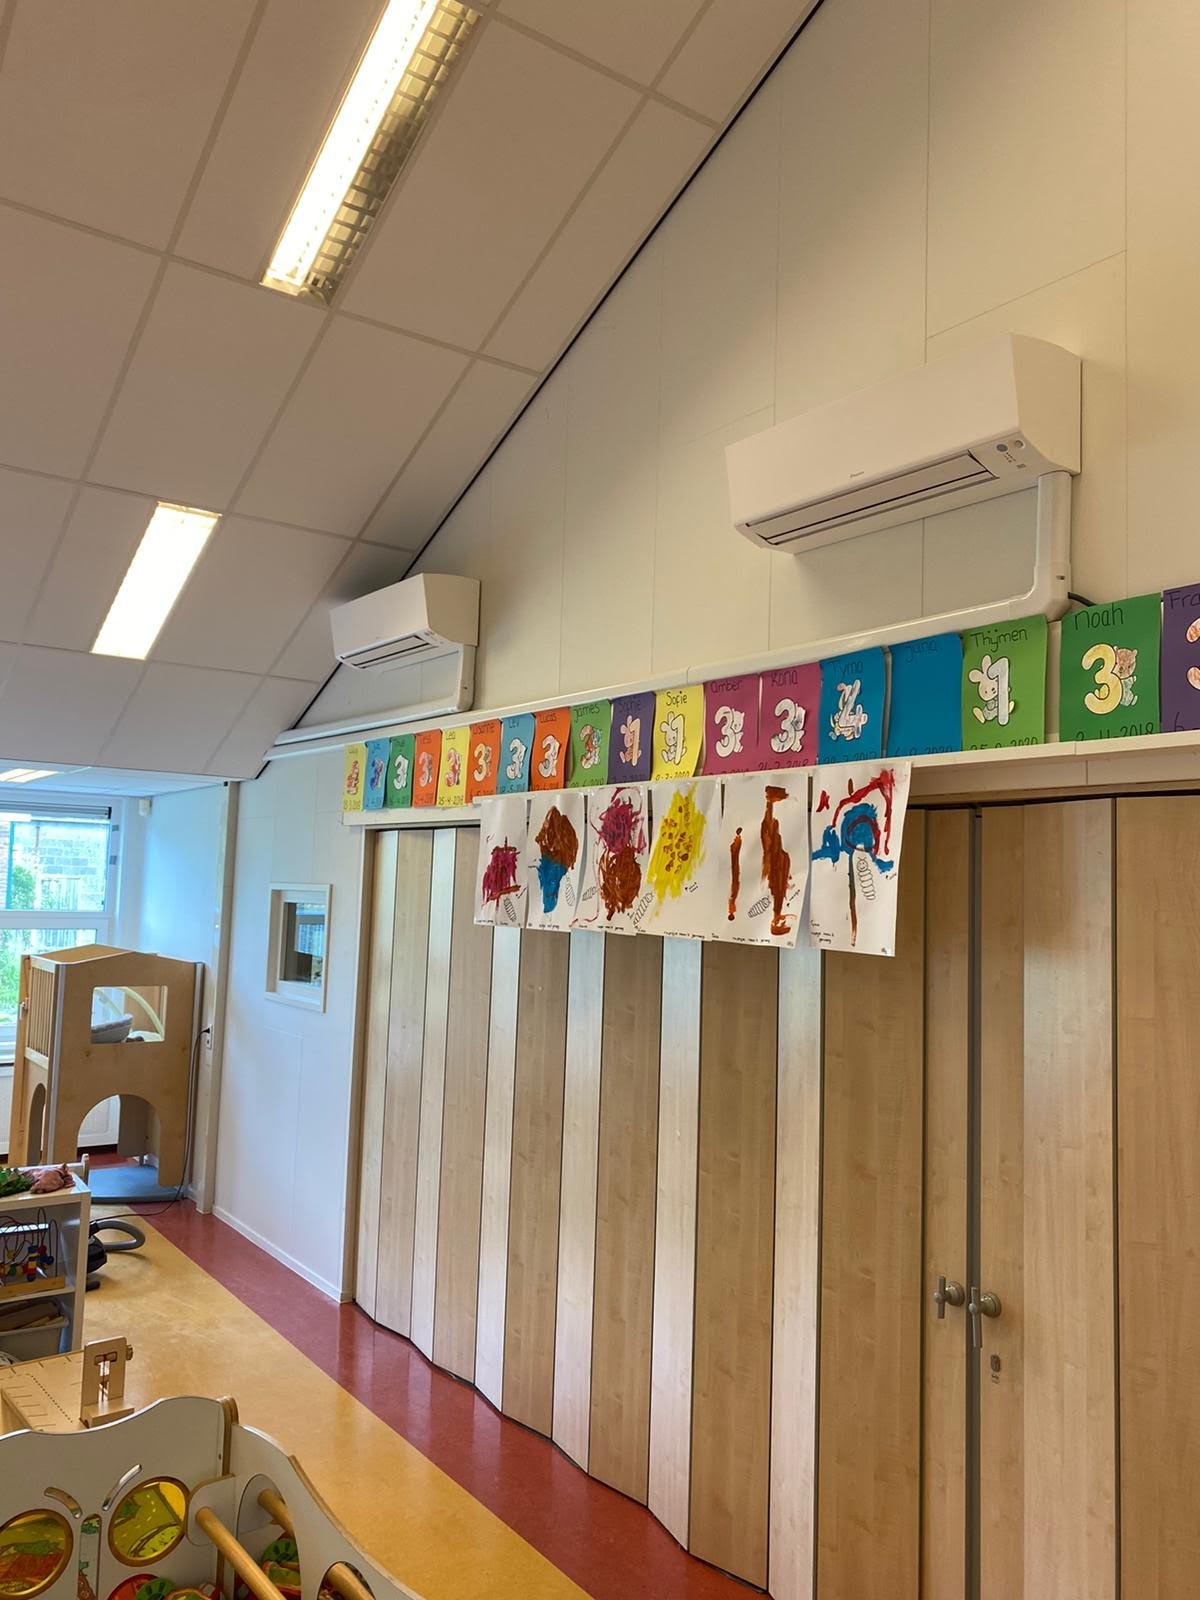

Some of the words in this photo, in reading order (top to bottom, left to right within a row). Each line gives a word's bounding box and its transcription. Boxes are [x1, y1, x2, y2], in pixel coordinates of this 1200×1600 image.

[665, 690, 688, 708] Sofie
[987, 656, 1010, 727] 1
[1081, 642, 1122, 715] 3
[630, 717, 642, 766] 1
[671, 713, 686, 766] 1
[715, 705, 737, 758] 3
[771, 697, 797, 754] 3
[473, 743, 488, 782] 3
[506, 737, 523, 781] 3
[537, 734, 557, 779] 3
